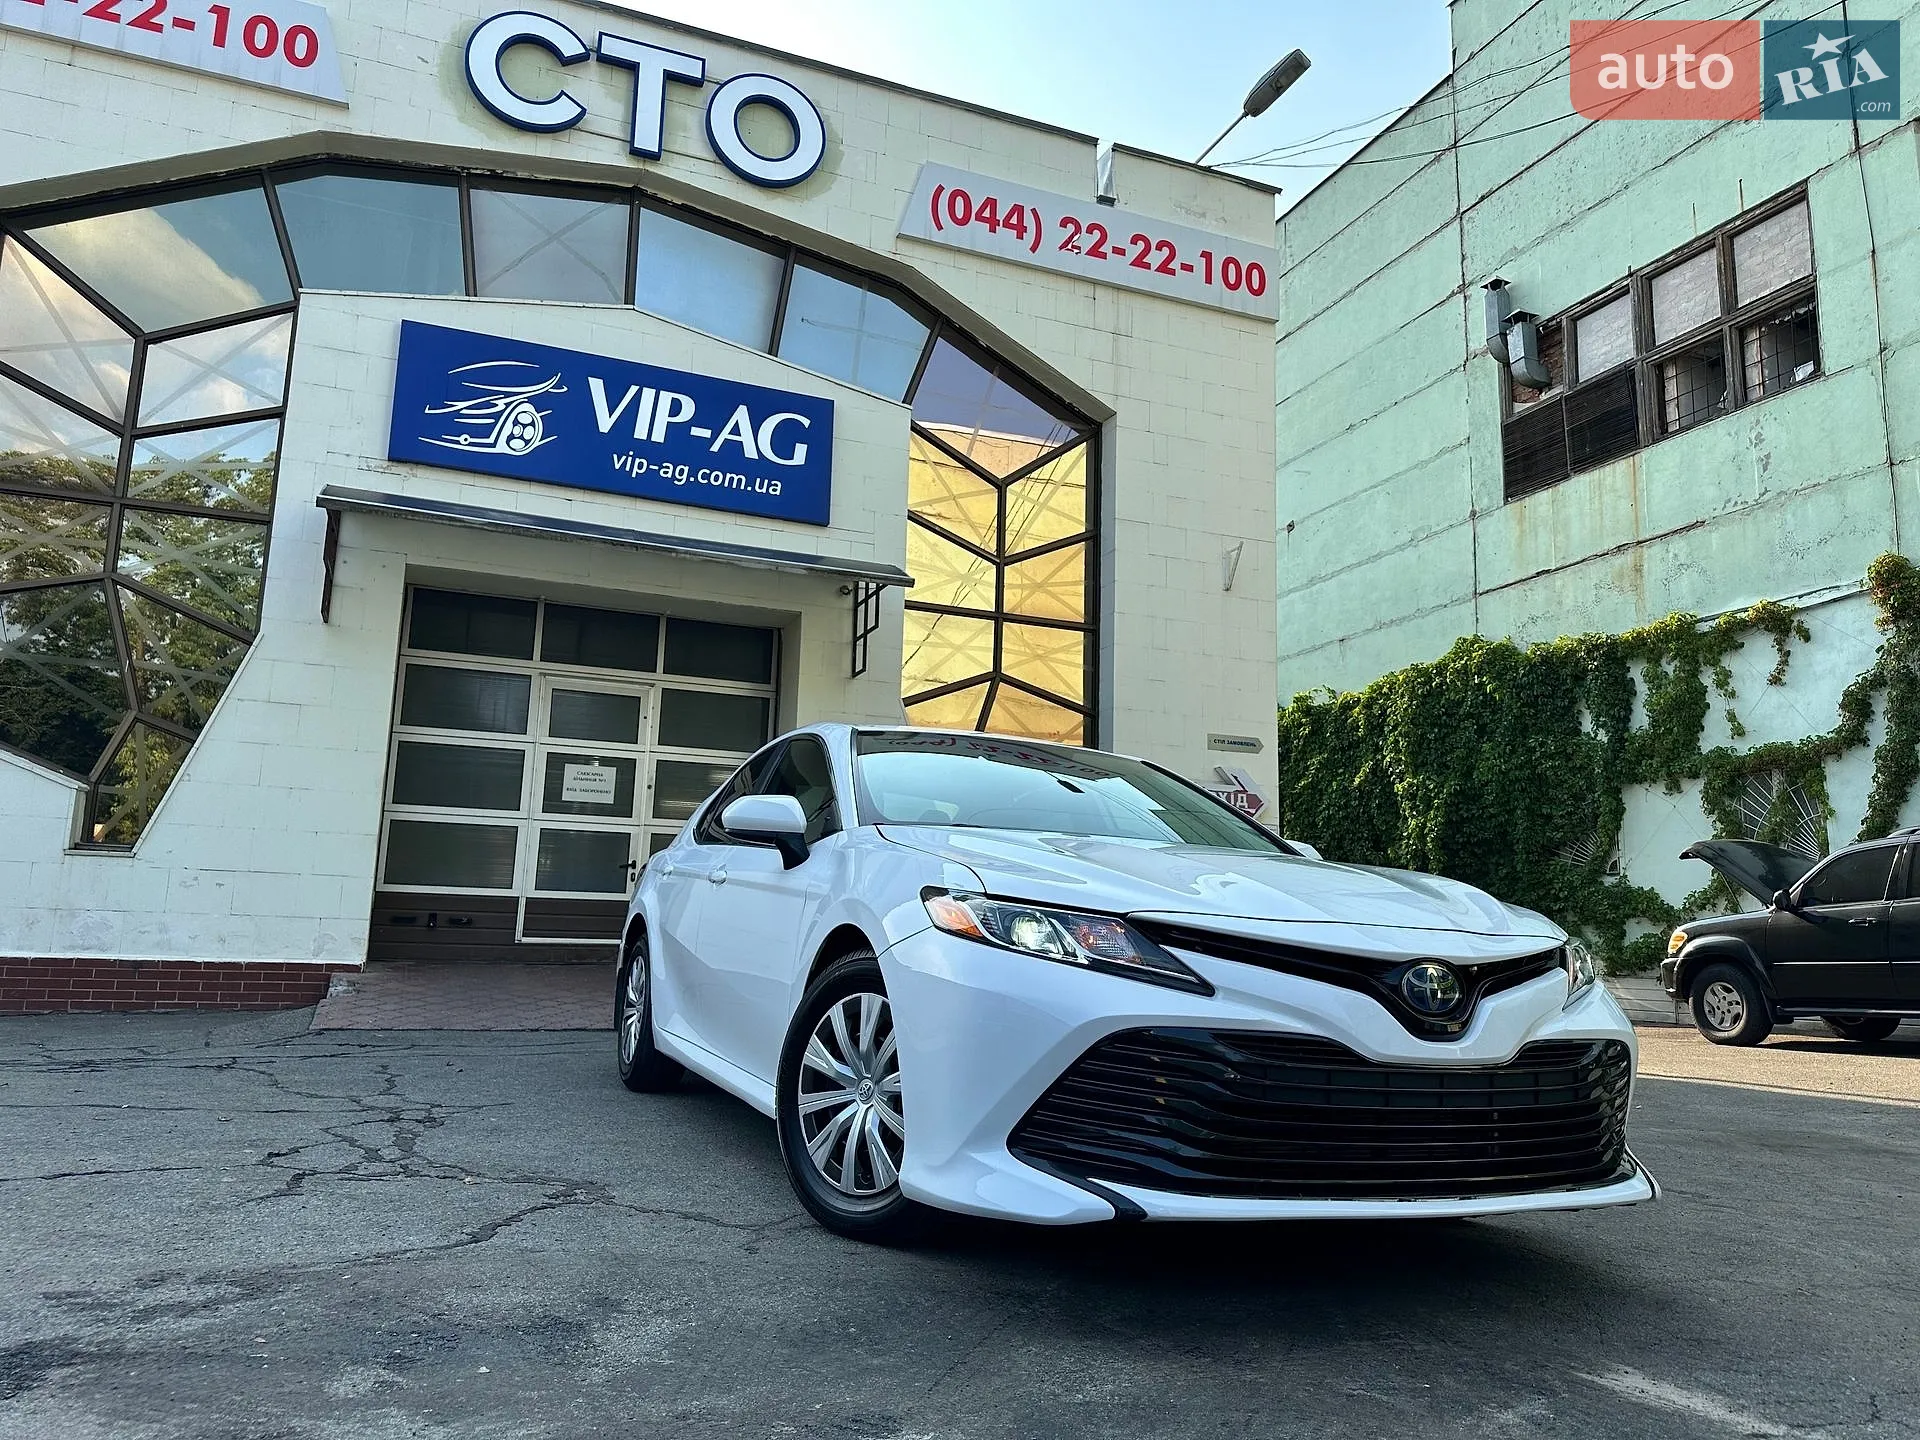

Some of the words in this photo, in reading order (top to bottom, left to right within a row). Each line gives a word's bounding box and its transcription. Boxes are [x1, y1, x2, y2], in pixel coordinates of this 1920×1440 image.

[18, 0, 320, 68] 22-100
[463, 10, 828, 187] СТО
[931, 184, 1043, 254] (044)
[1058, 216, 1267, 297] 22-22-100
[587, 376, 811, 464] VIP-AG
[612, 451, 782, 496] vip-ag.com.ua
